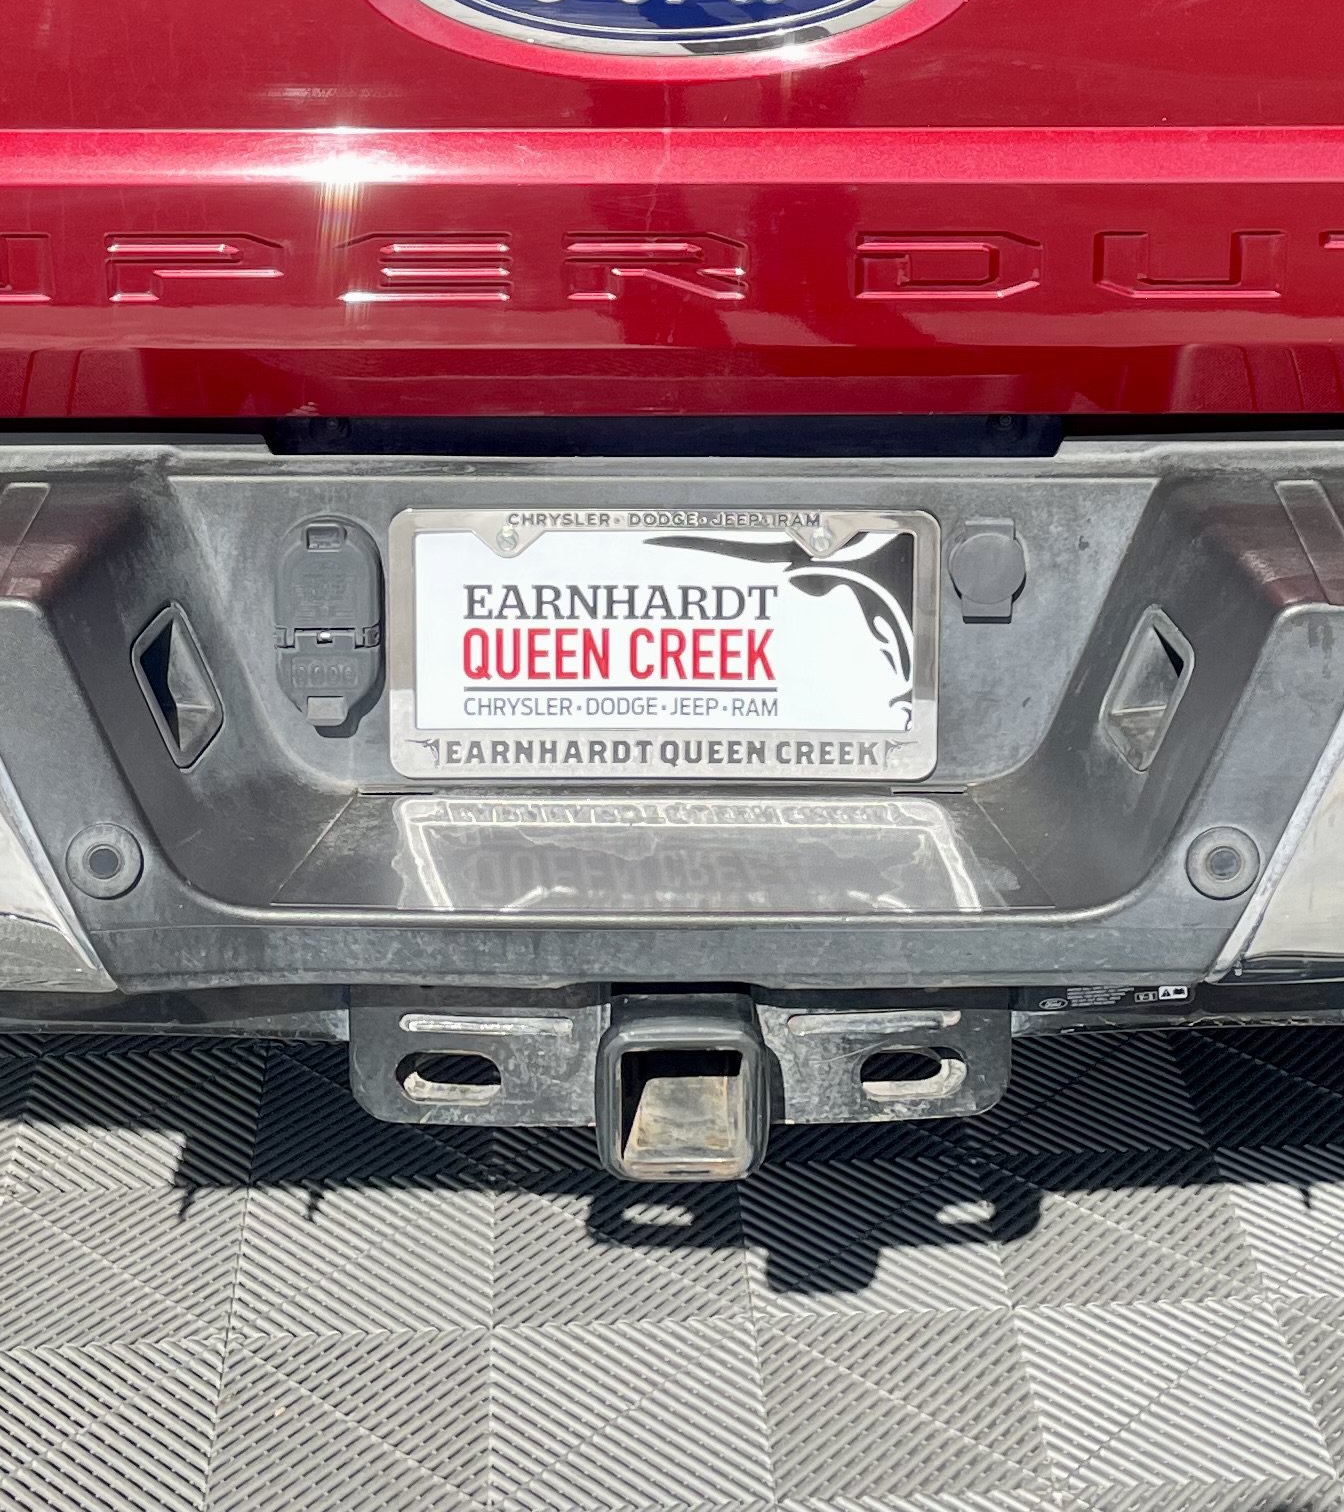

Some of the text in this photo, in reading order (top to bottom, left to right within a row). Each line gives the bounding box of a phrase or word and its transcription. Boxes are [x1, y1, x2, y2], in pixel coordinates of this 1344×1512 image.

[507, 512, 821, 528] CHRYSLER DODGE JEEP RAM
[463, 584, 778, 620] EARNHARDT
[462, 628, 775, 681] QUEEN CREEK
[463, 697, 779, 717] CHRYSLER DODGE JEEP RAM
[445, 739, 880, 767] EARNHARDT QUEEN CREEK
